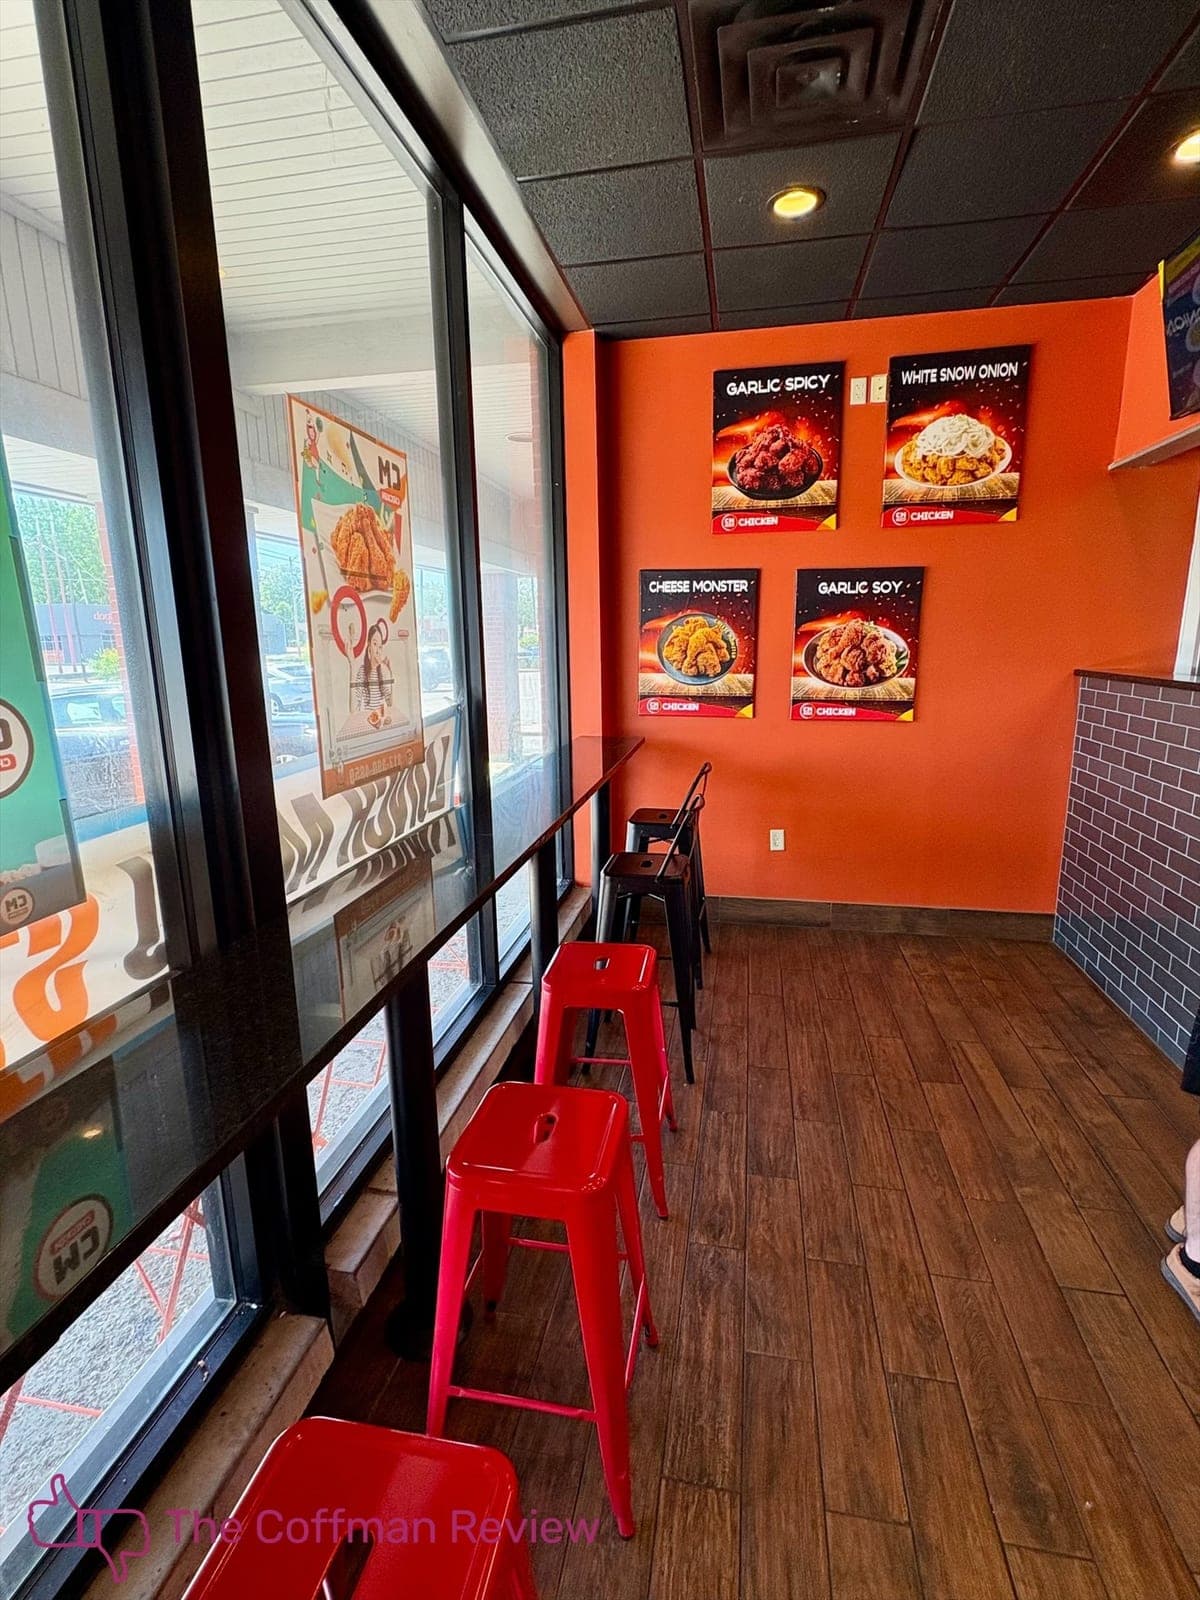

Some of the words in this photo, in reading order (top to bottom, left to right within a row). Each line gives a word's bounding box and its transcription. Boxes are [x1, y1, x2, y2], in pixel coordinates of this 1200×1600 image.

[901, 368, 938, 385] WHITE
[940, 365, 976, 382] SNOW
[978, 361, 1019, 379] ONION
[726, 378, 781, 396] GARLIC
[785, 374, 831, 391] SPICY
[738, 516, 779, 526] CHICKEN
[910, 510, 954, 521] CHICKEN
[649, 580, 690, 593] CHEESE
[692, 580, 748, 592] MONSTER
[818, 581, 869, 595] GARLIC
[872, 580, 903, 593] SOY
[662, 702, 700, 712] CHICKEN
[816, 707, 857, 716] CHICKEN
